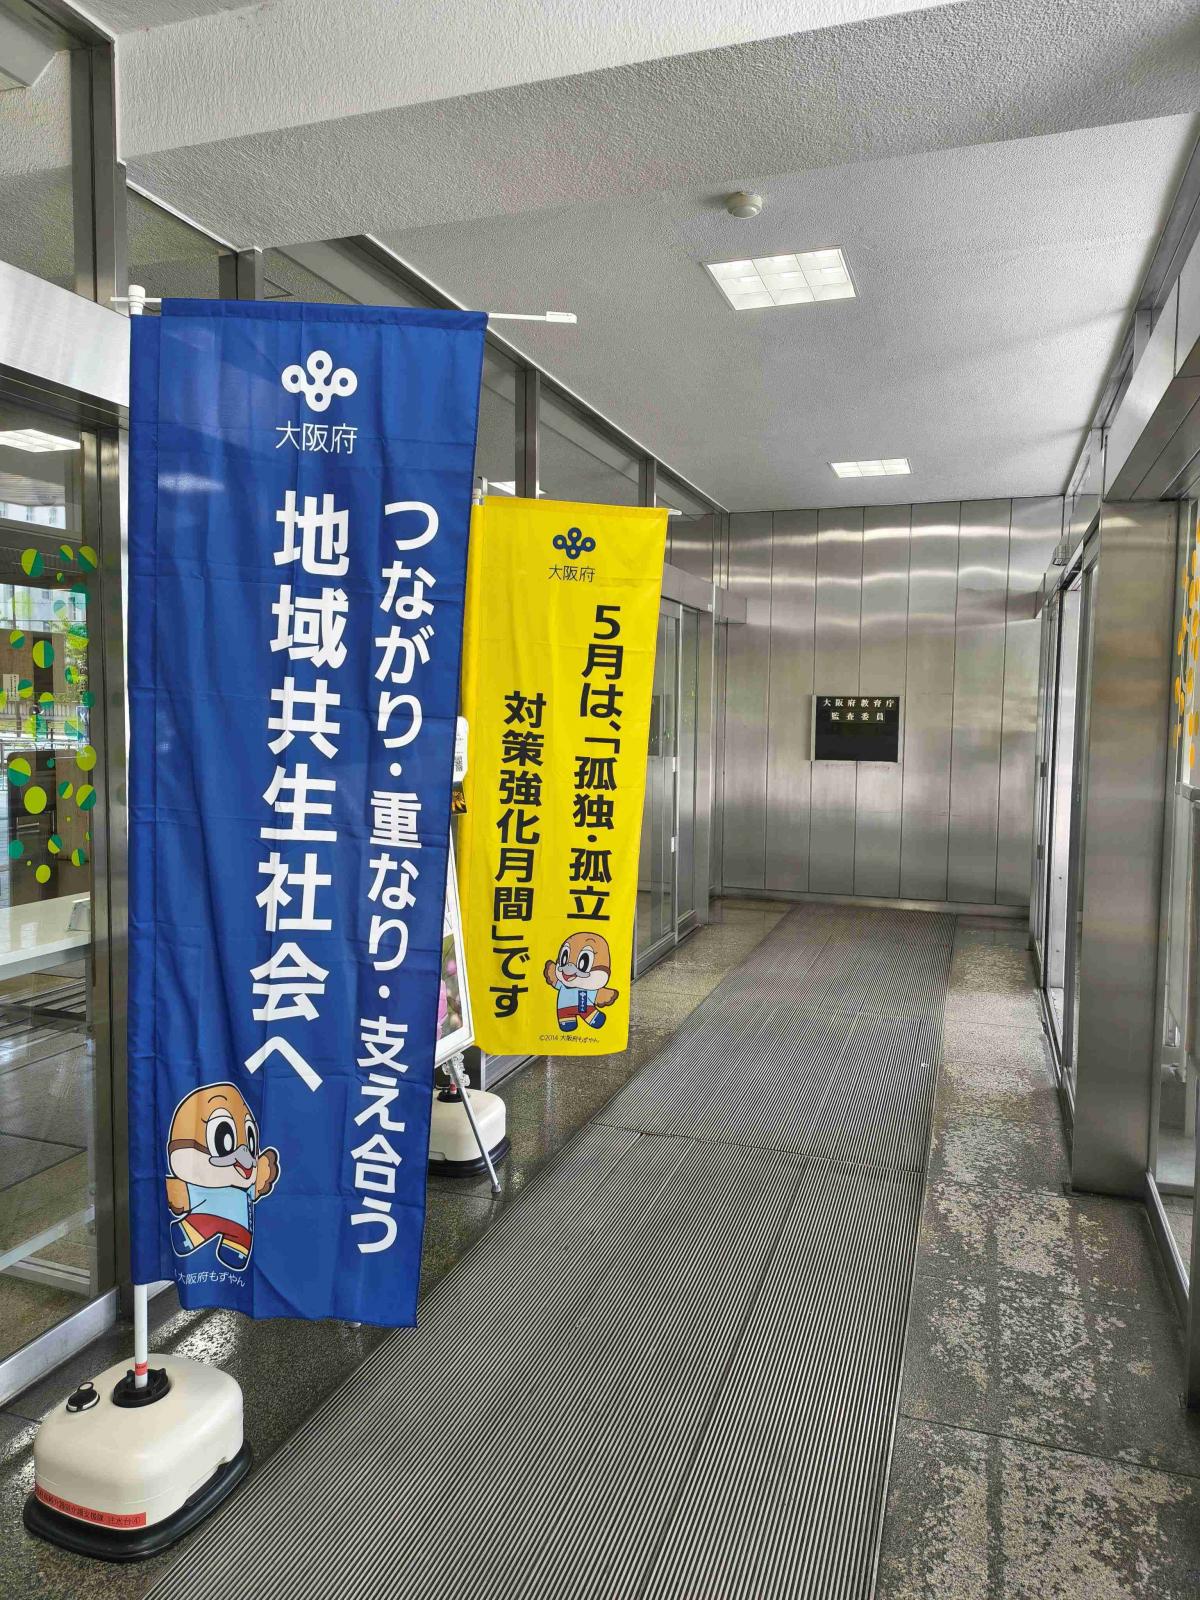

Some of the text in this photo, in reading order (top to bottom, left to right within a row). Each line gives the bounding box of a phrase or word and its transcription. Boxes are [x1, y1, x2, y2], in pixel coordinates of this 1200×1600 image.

[275, 420, 358, 455] 大阪府
[548, 564, 596, 583] 大阪府
[244, 489, 350, 1093] 地域共生社会へ
[823, 698, 895, 708] 大阪府教育庁
[350, 500, 439, 1254] つながり・重なり・支え合う
[489, 690, 547, 1018] 対策強化月間」です
